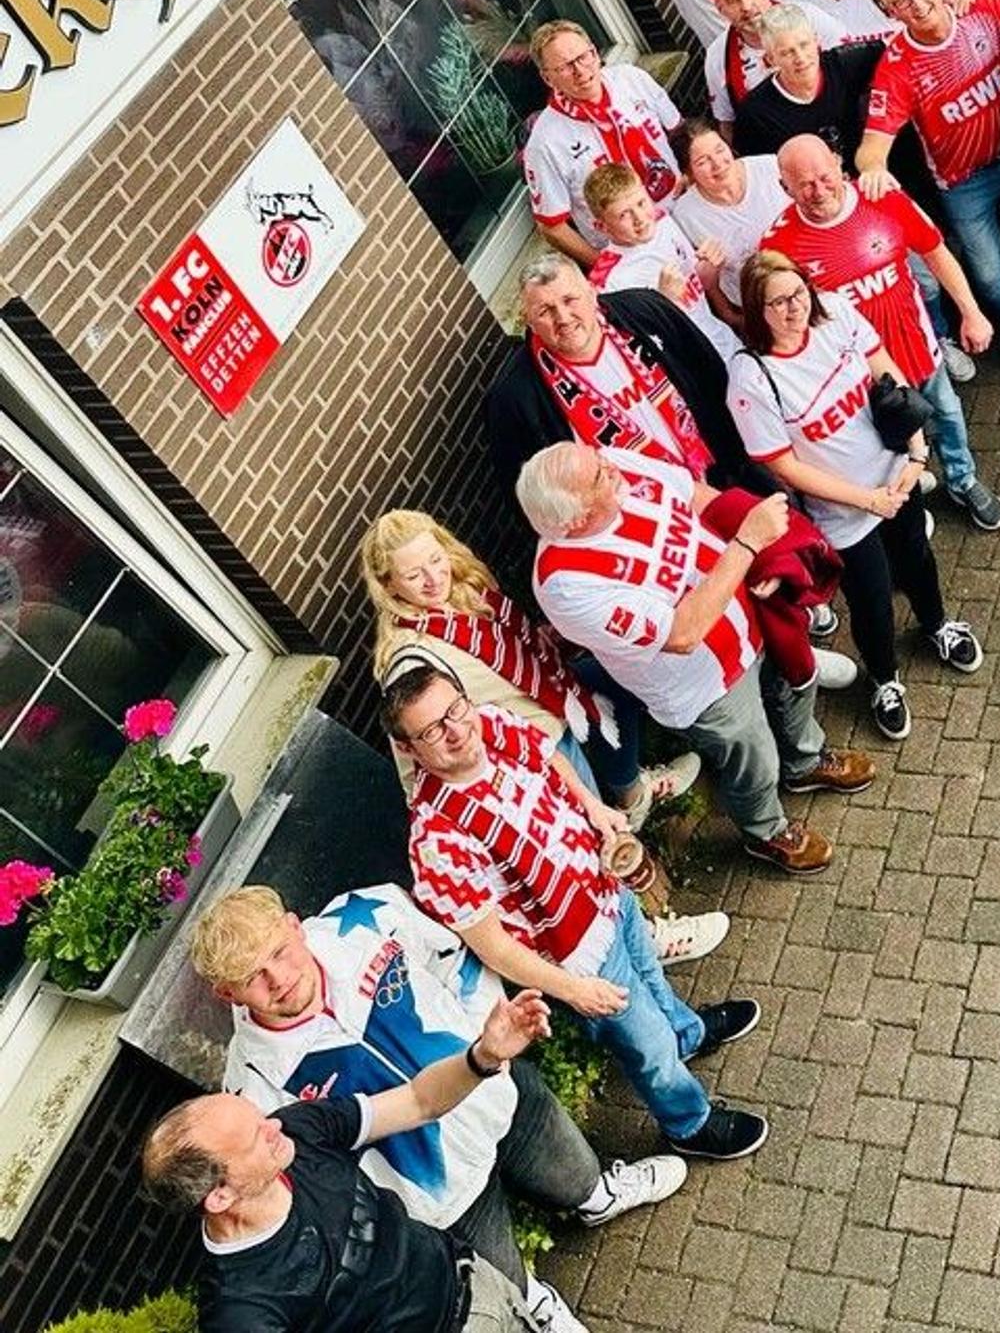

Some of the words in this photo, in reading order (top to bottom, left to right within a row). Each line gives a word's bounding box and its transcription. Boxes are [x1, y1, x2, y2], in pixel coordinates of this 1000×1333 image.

[837, 263, 899, 305] EWE
[181, 289, 234, 355] FANCLUB
[199, 312, 250, 381] EFFZEH
[209, 326, 263, 394] DETTEN
[801, 374, 874, 443] REWE
[655, 497, 693, 594] REWE
[527, 784, 560, 849] EW
